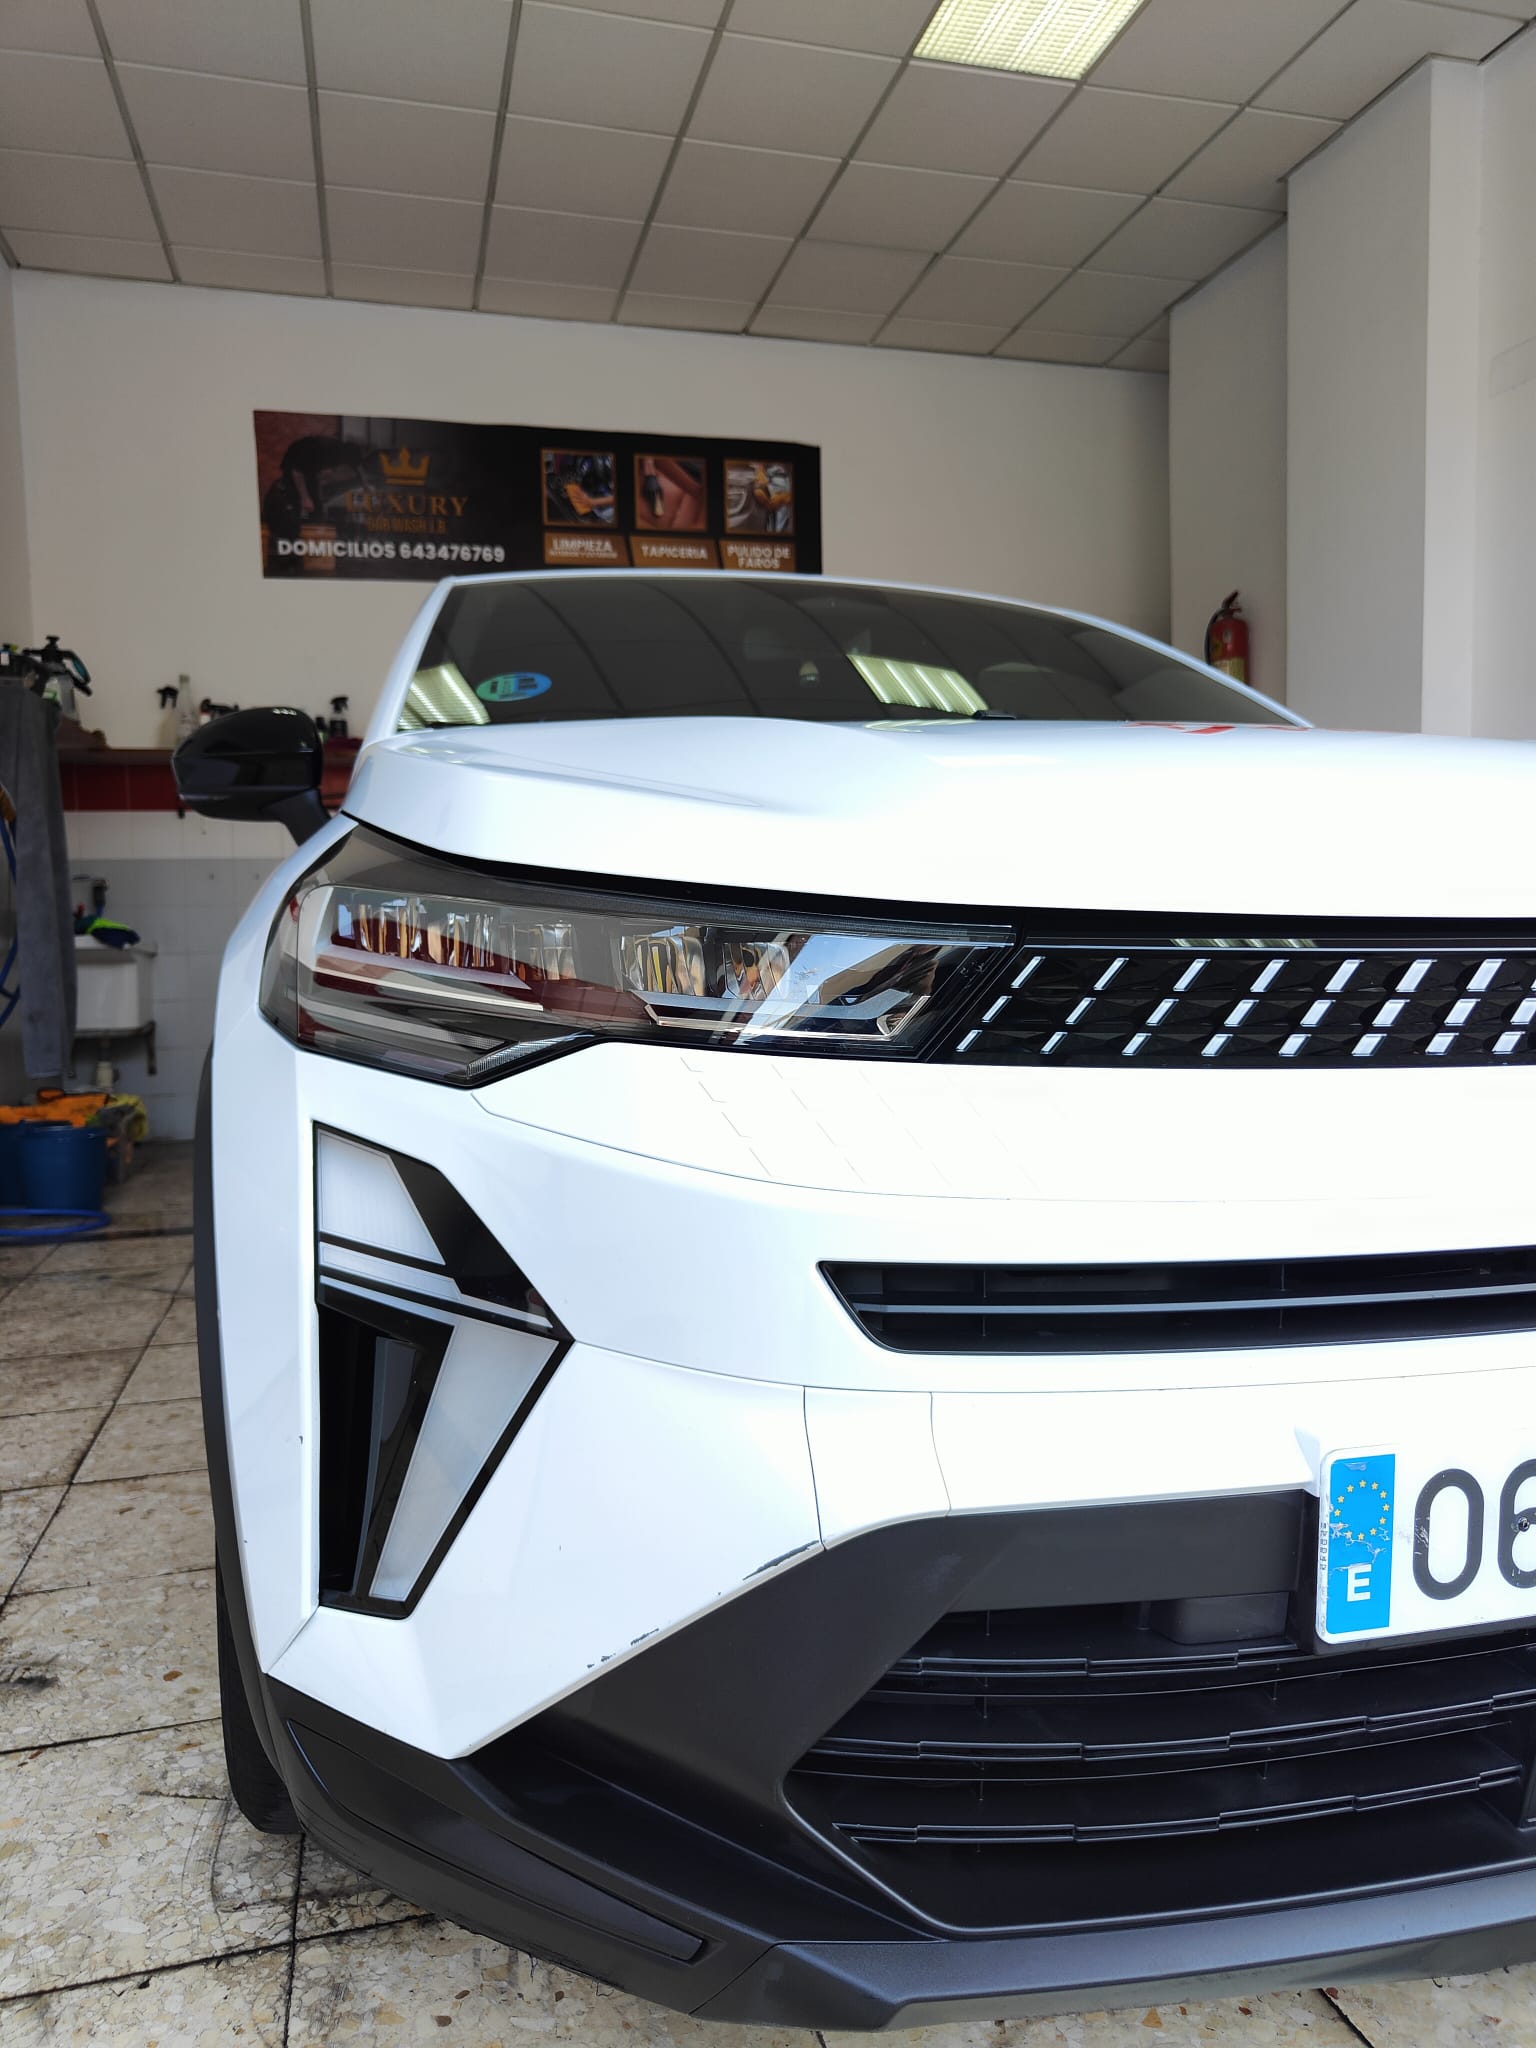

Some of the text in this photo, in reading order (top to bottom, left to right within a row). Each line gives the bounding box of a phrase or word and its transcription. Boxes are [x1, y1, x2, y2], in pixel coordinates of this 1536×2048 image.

[345, 490, 468, 517] LUXURY
[277, 539, 506, 563] DOMICILIOS 643476769
[552, 538, 613, 552] LIMPIEZA
[726, 543, 791, 560] PULIDO DE
[737, 557, 781, 570] FAROS
[1346, 1563, 1372, 1602] E
